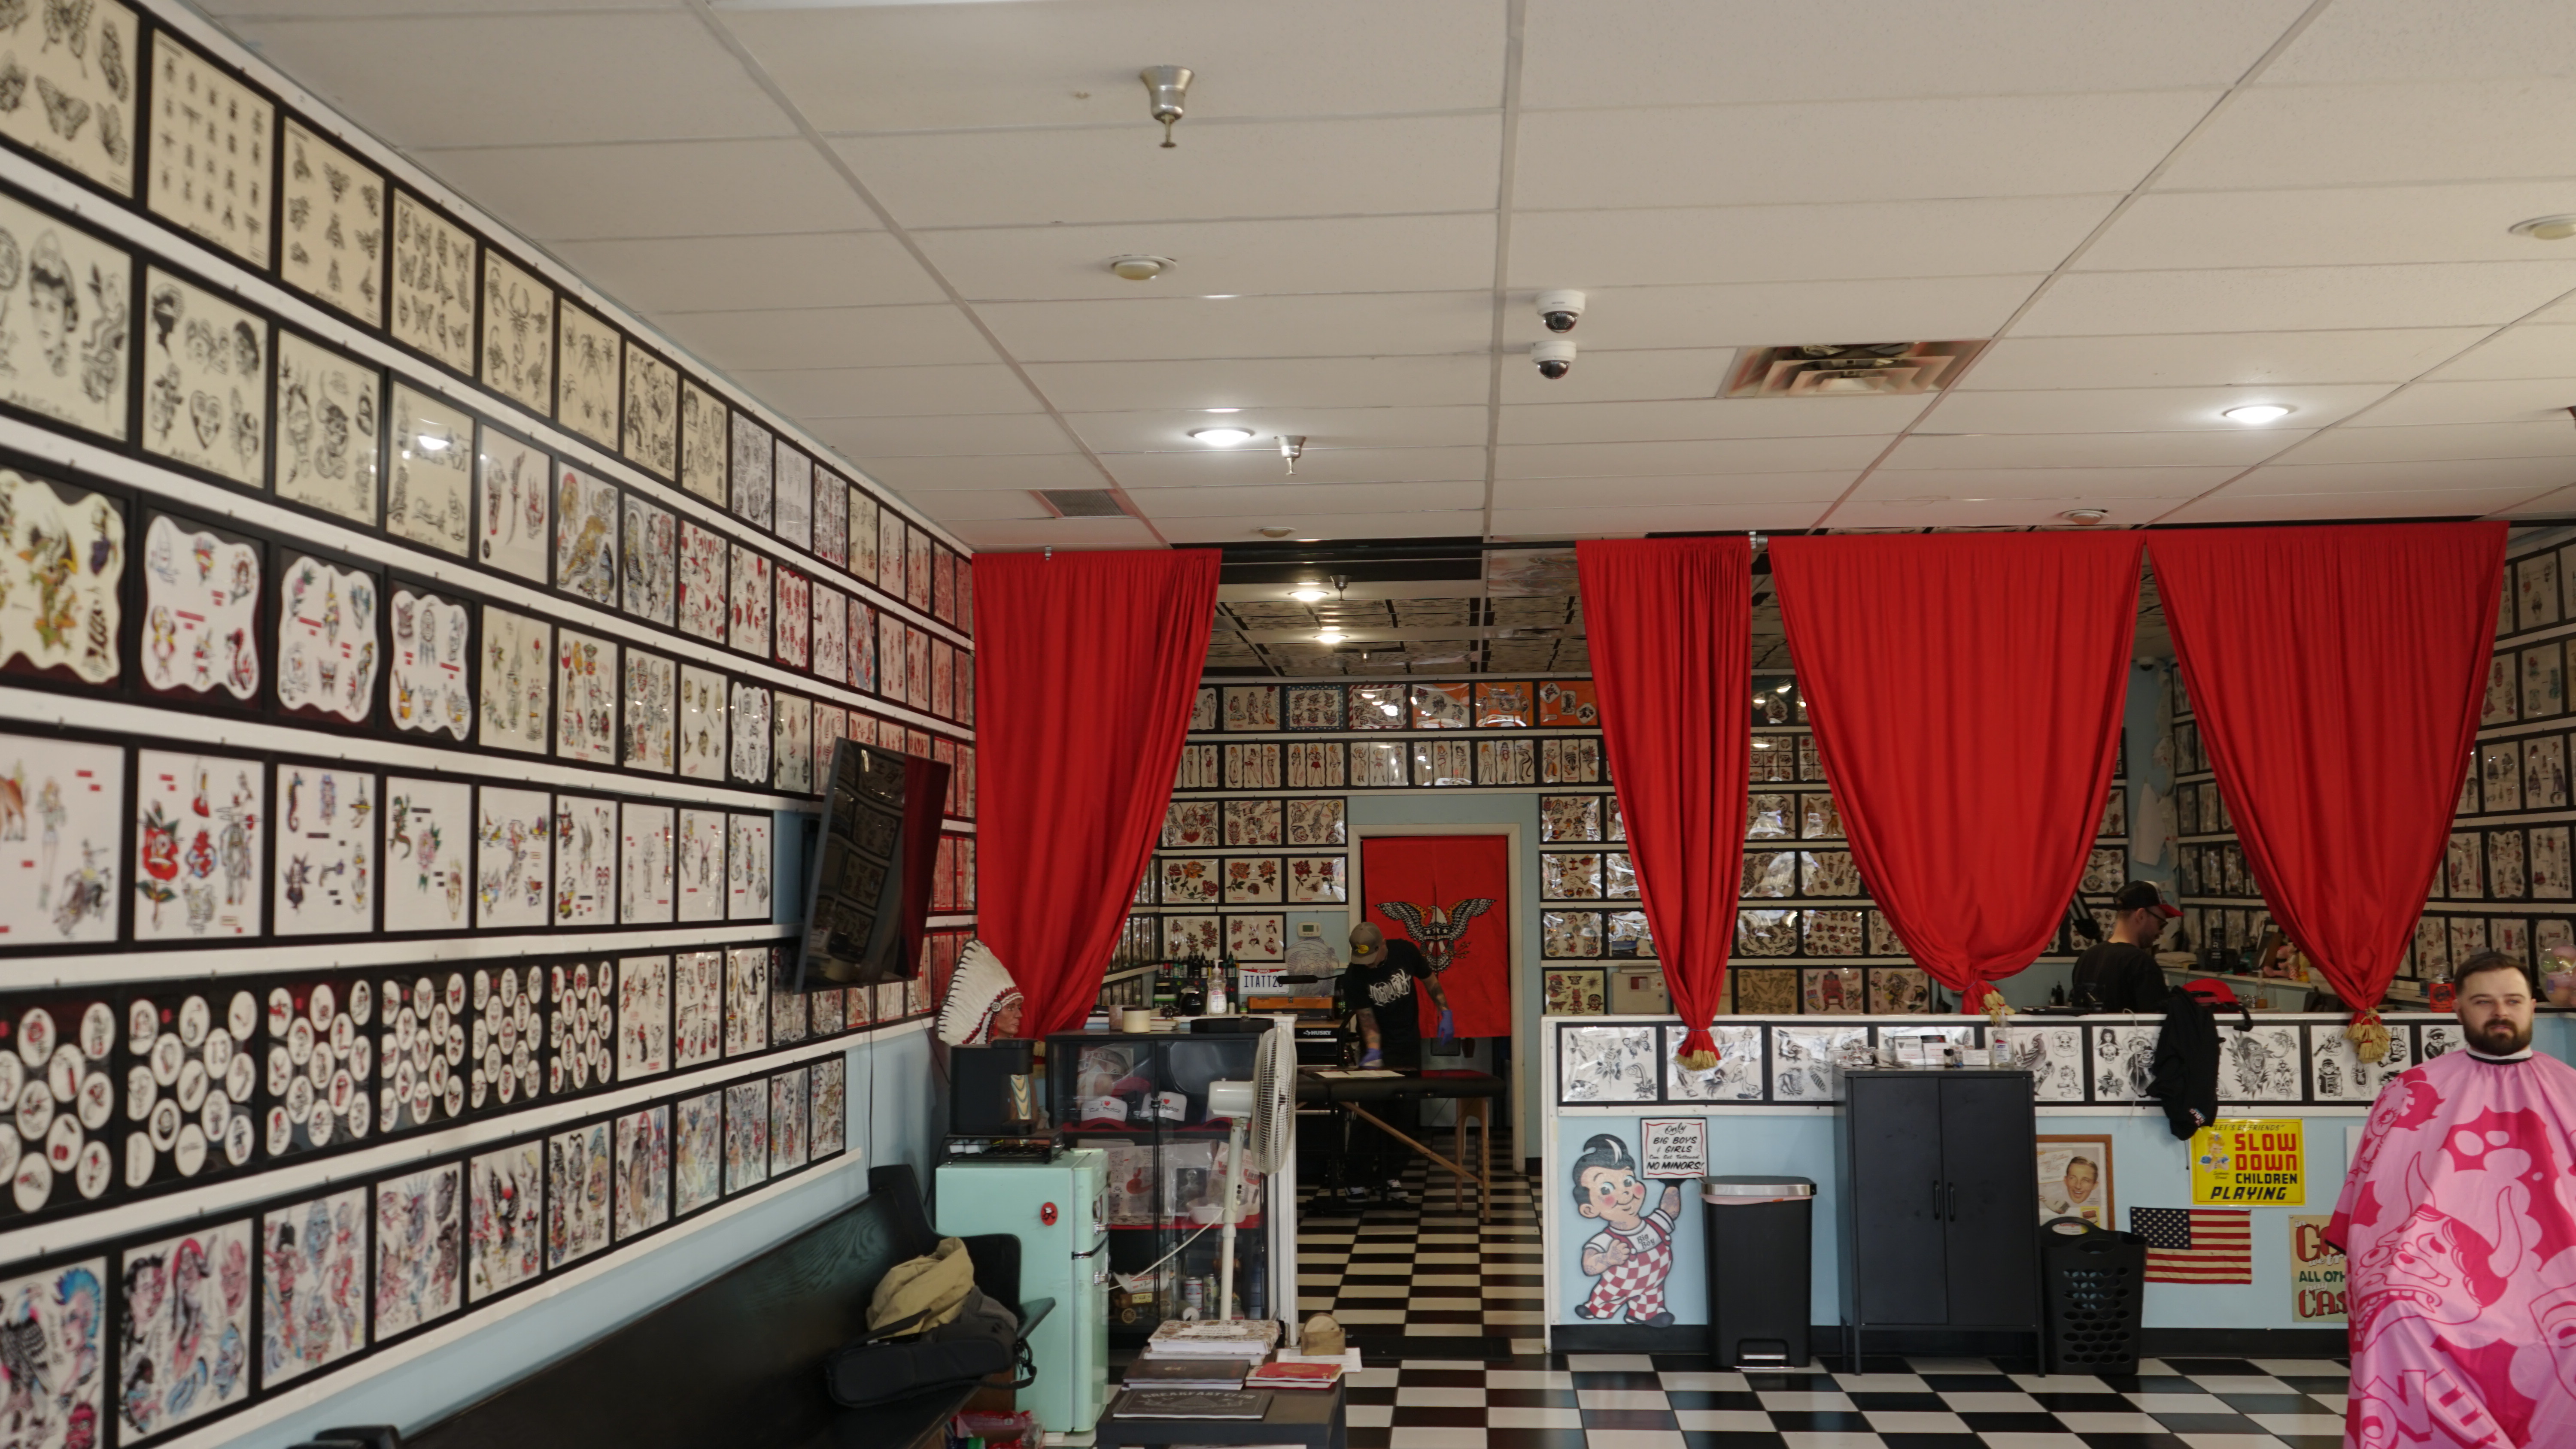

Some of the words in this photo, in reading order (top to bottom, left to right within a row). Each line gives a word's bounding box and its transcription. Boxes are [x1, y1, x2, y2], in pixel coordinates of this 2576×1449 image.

[1665, 1122, 1687, 1135] Only
[2235, 1134, 2297, 1151] SLOW
[1662, 1161, 1705, 1170] MINORS!
[2235, 1154, 2297, 1171] DOWN
[2236, 1173, 2297, 1184] CHILDREN
[2210, 1187, 2287, 1200] PLAYING
[1637, 1234, 1649, 1244] Big
[1642, 1238, 1655, 1249] Boy
[2296, 1224, 2341, 1262] GO
[2309, 1258, 2324, 1267] we
[2299, 1271, 2321, 1282] ALL
[2306, 1282, 2327, 1296] pay
